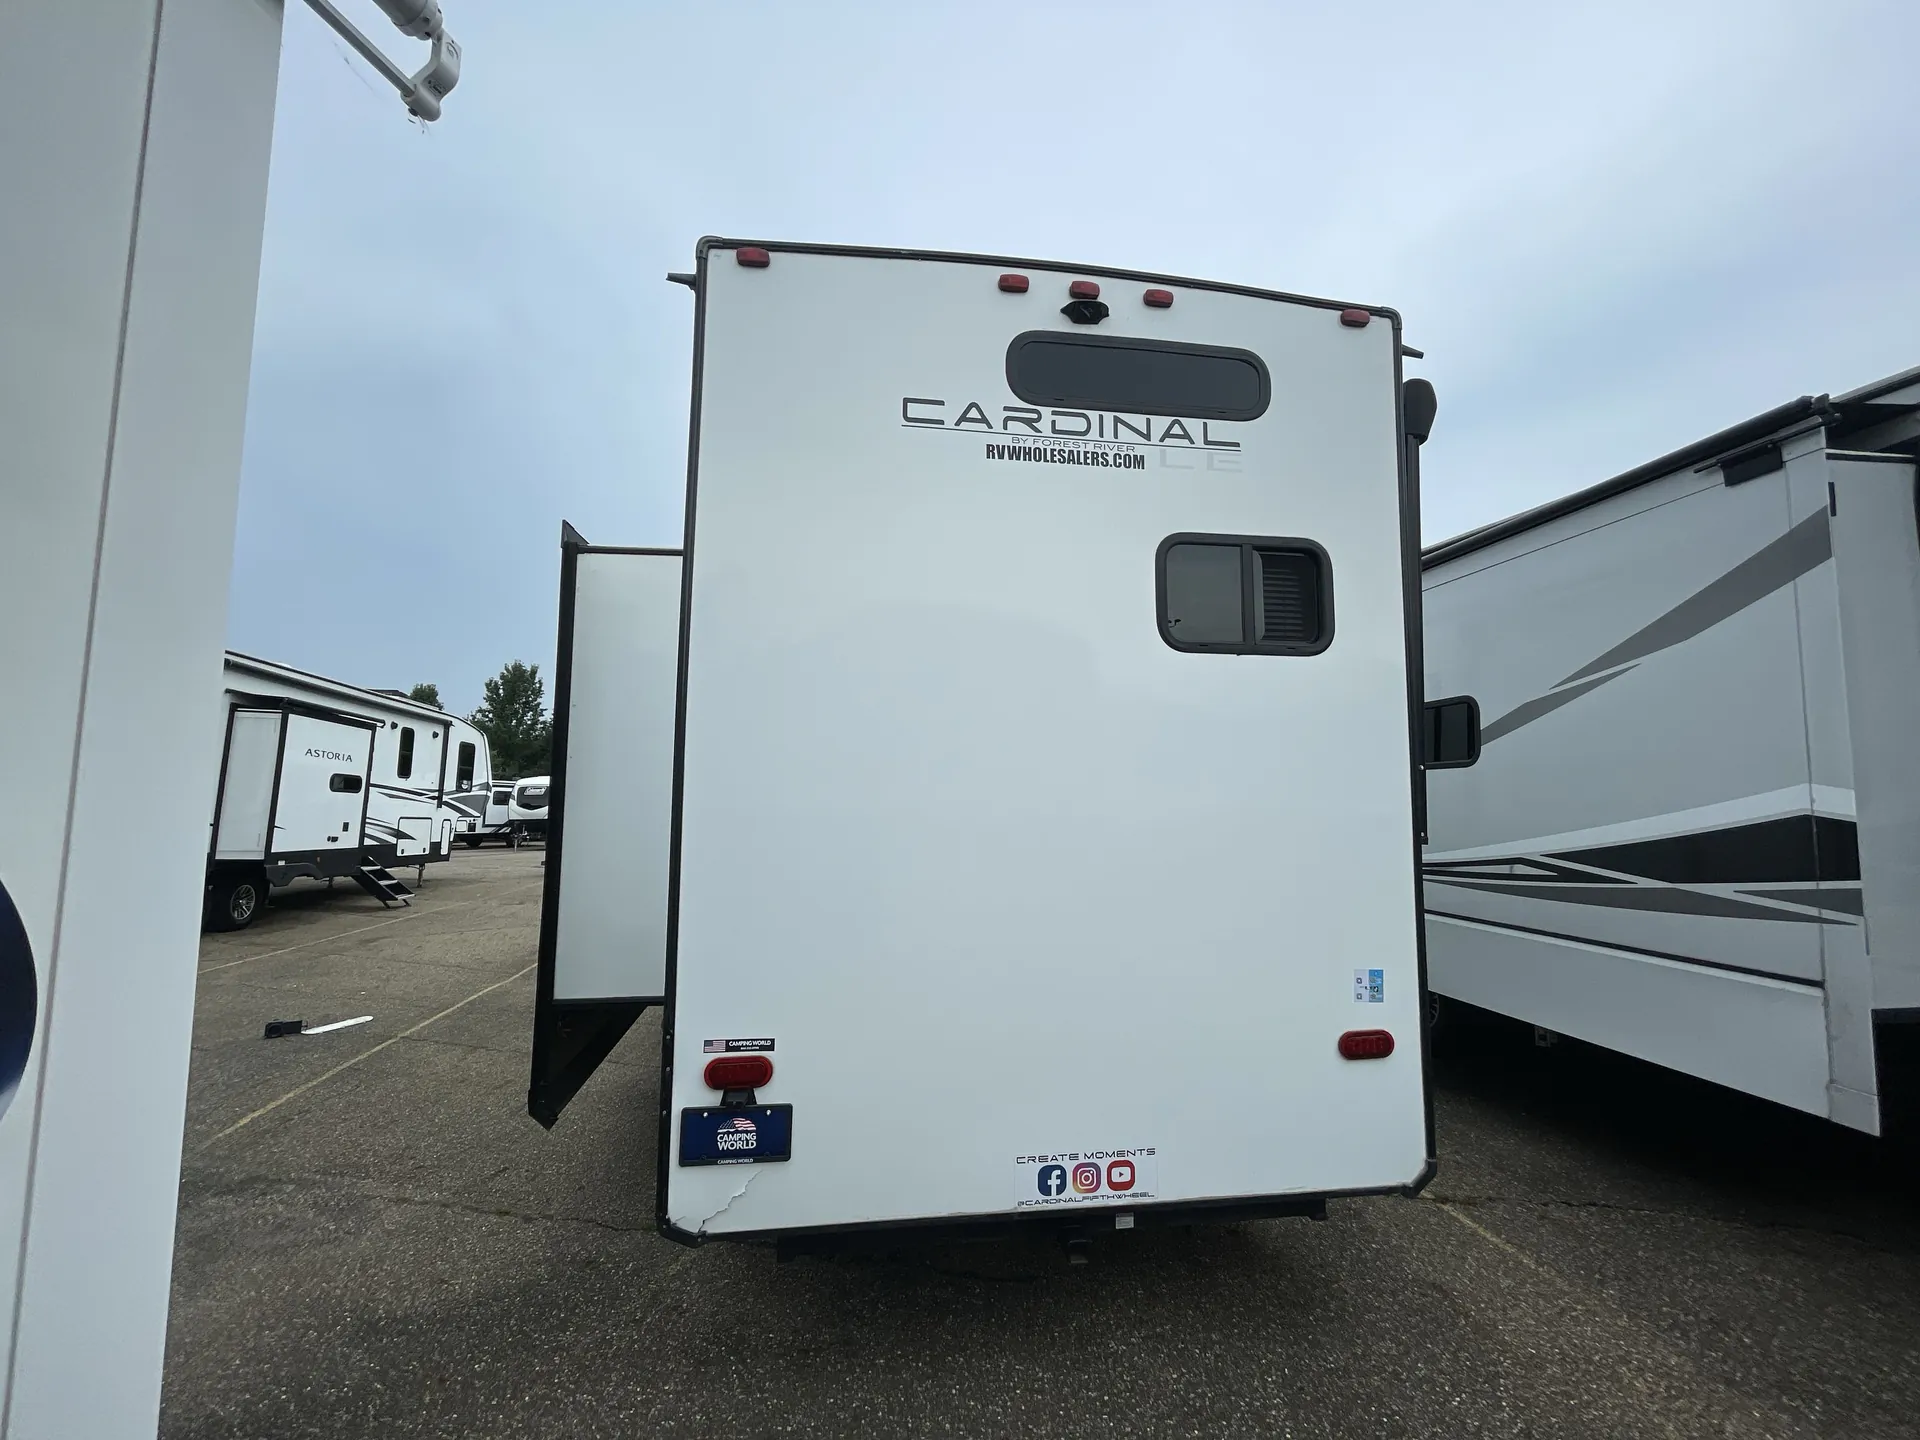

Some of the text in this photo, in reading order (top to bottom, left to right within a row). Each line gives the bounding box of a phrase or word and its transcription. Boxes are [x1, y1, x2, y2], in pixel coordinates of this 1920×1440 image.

[902, 397, 1241, 448] CARDINAL
[1011, 436, 1136, 453] BY FOREST RIVER
[986, 443, 1145, 470] RVWHOLESALERS.COM
[304, 748, 353, 763] ASTORIA
[717, 1133, 757, 1142] CAMPING
[717, 1140, 757, 1151] WORLD
[1016, 1147, 1156, 1165] CREATE MOMENTS
[1017, 1191, 1155, 1207] @CARDINALFIFTHWHEEL
